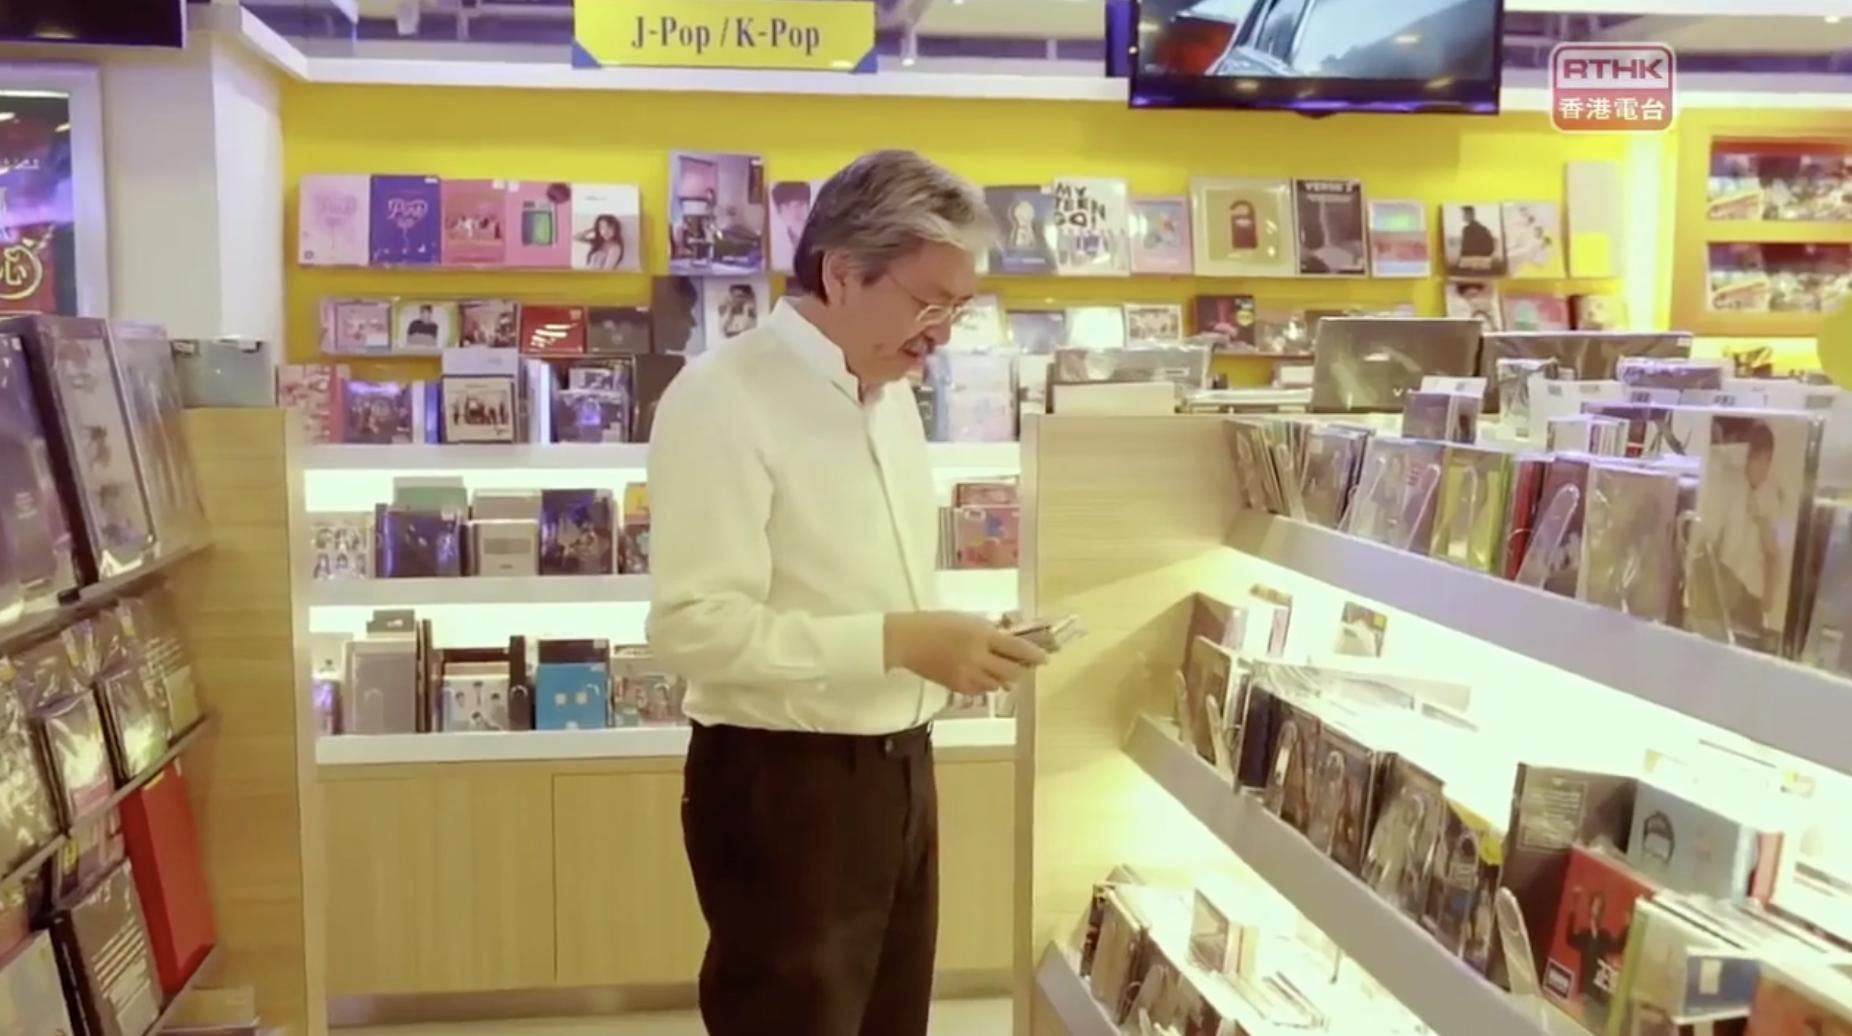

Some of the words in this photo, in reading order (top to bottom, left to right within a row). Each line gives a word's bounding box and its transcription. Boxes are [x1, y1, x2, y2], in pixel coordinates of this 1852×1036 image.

[632, 16, 710, 54] J-Pop
[736, 17, 819, 55] K-Pop
[1056, 183, 1086, 197] MY
